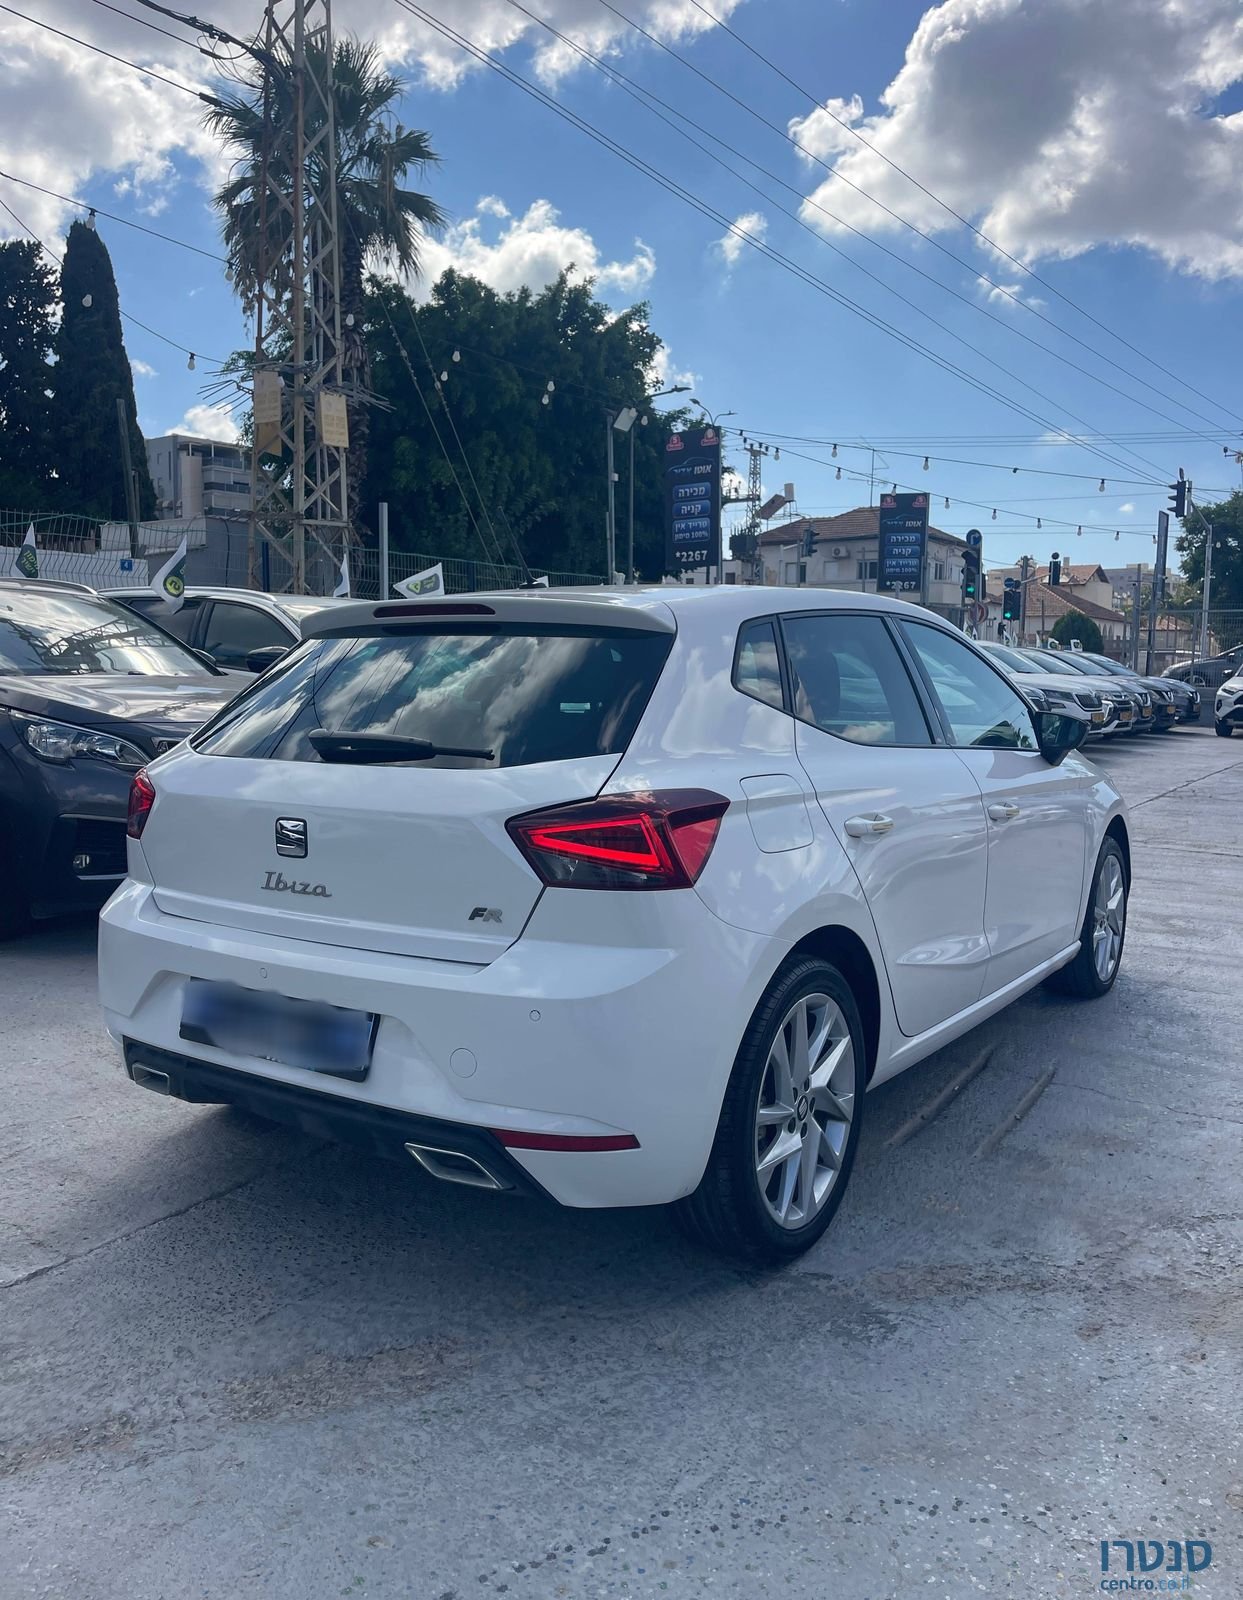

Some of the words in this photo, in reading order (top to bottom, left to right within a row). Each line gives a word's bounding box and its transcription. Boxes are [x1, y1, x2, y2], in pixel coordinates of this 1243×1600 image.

[694, 464, 712, 475] אוטו
[678, 487, 706, 497] מכירה
[681, 504, 702, 516] קניה
[675, 522, 686, 532] אין
[905, 520, 923, 528] אוטו
[691, 530, 709, 539] 100%
[890, 535, 916, 543] מכירה
[892, 548, 912, 557] קניה
[261, 871, 332, 897] Ibiza
[468, 906, 503, 923] FR
